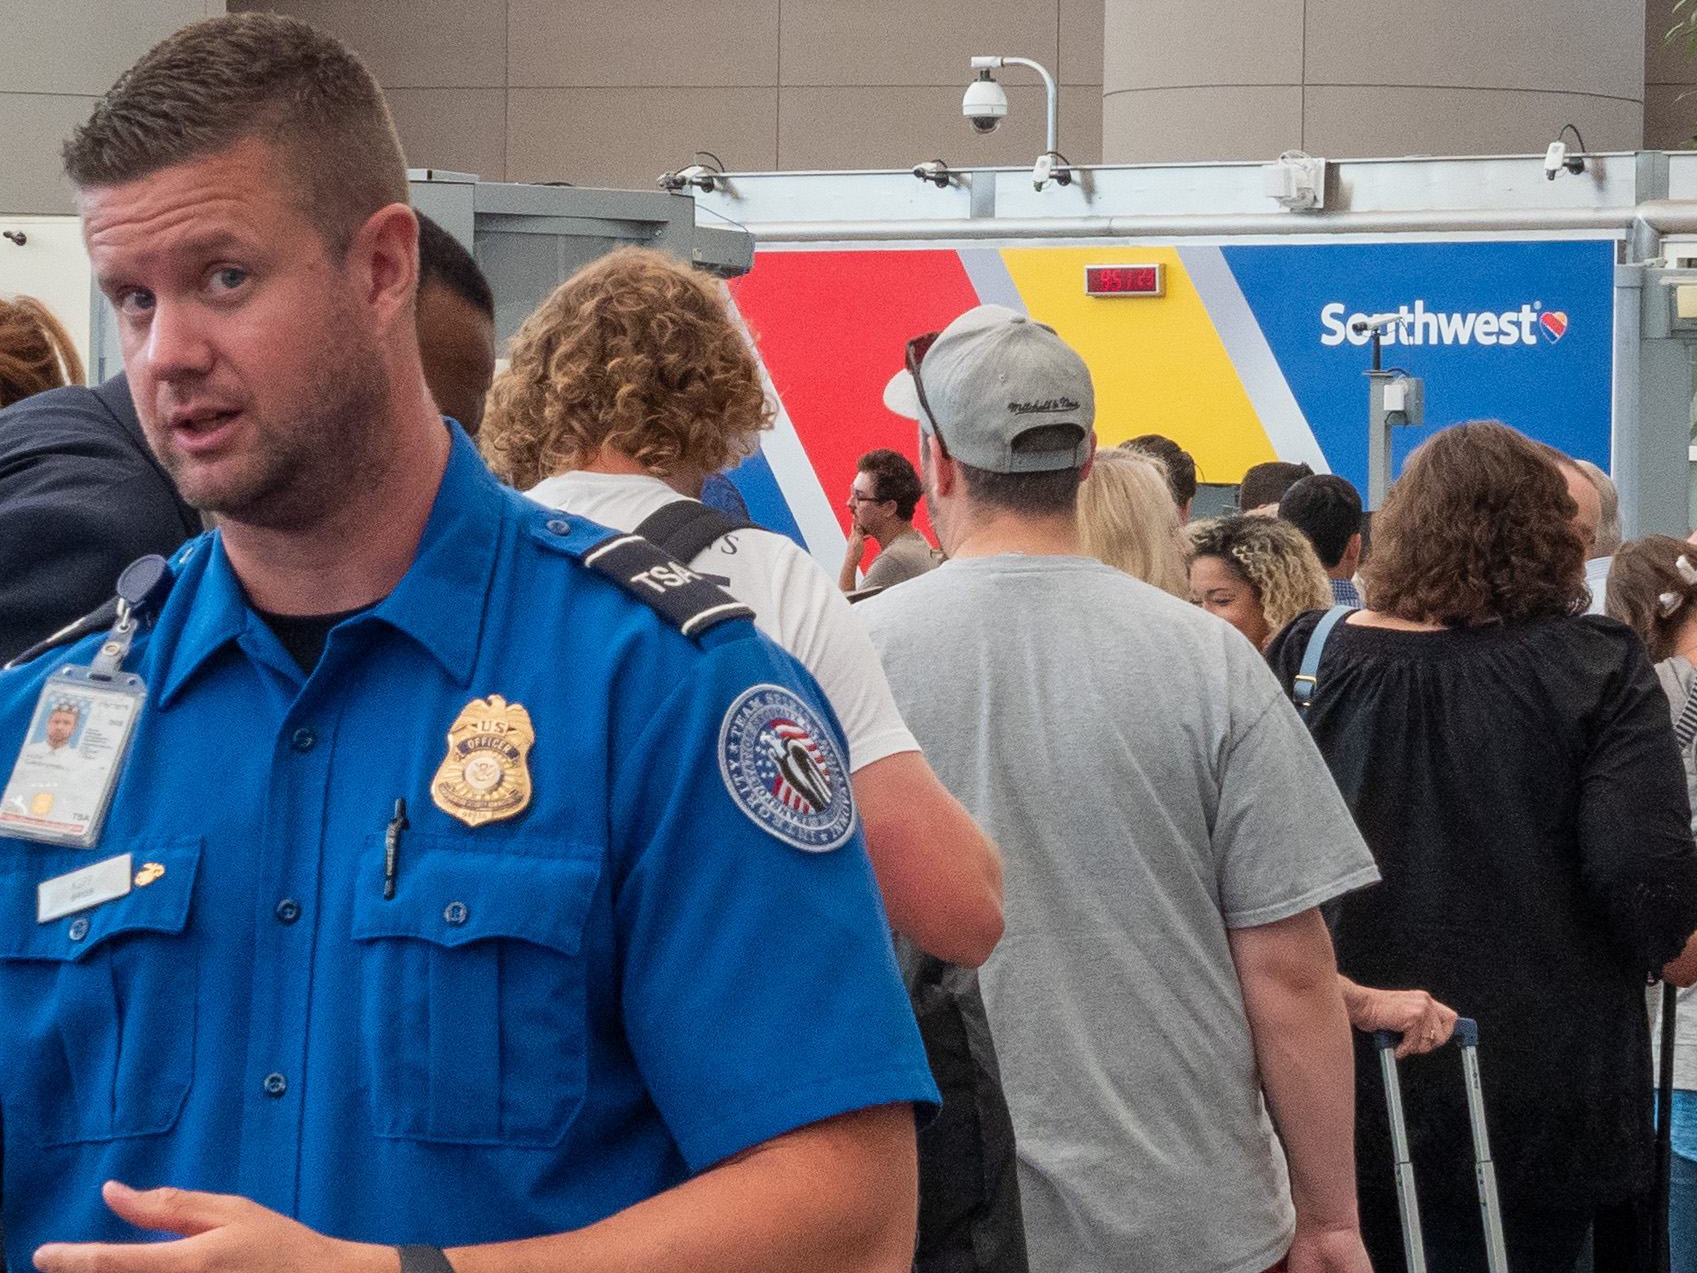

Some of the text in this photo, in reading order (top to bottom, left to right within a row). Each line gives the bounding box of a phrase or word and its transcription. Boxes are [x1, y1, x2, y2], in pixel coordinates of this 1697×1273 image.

[1320, 299, 1537, 346] Southwest
[630, 561, 704, 594] TSA
[480, 720, 506, 734] US
[467, 737, 512, 753] OFFICER
